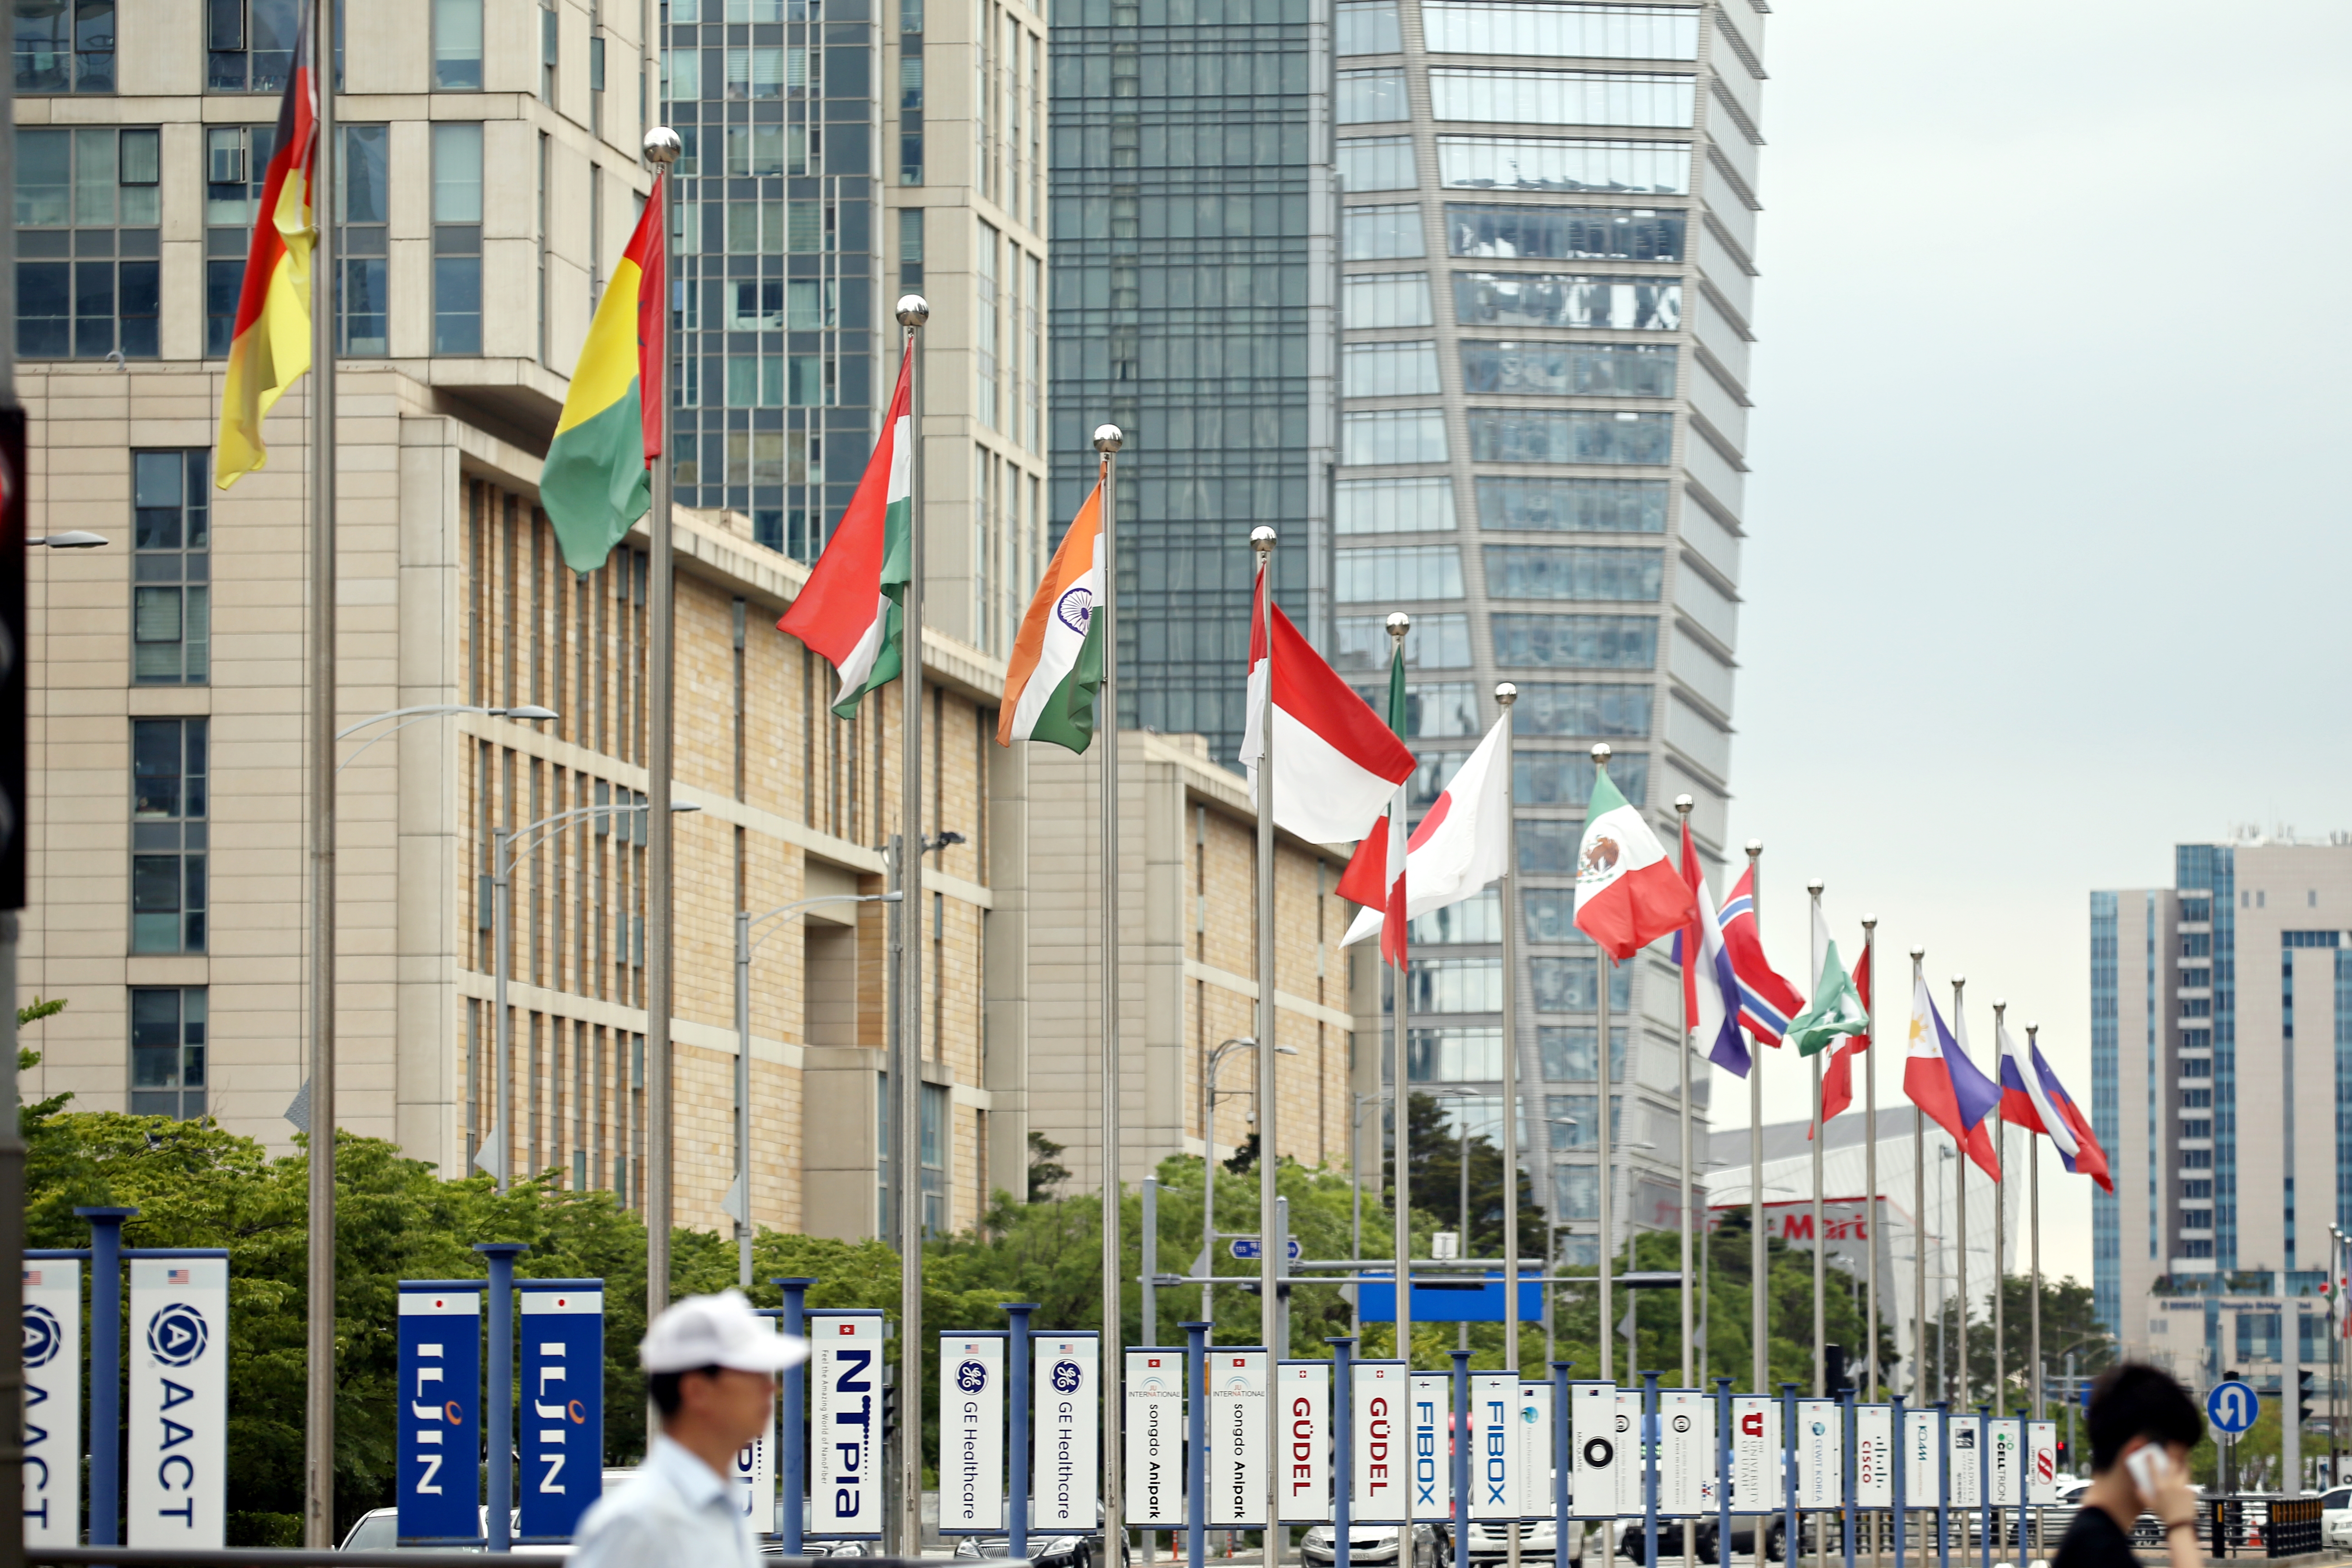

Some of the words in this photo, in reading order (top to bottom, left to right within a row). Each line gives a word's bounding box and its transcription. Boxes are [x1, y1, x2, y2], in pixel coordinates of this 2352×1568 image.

[820, 1381, 829, 1411] Amazing
[963, 1402, 978, 1423] GE
[1058, 1402, 1073, 1423] GE
[158, 1377, 194, 1529] AACT
[1147, 1404, 1160, 1456] songdo
[1232, 1404, 1245, 1455] songdo
[1293, 1397, 1313, 1497] GÜDEL
[1369, 1397, 1391, 1497] GÜDEL
[1416, 1401, 1435, 1506] FIBOX
[1487, 1401, 1505, 1505] FIBOX
[1741, 1441, 1749, 1453] OF
[1814, 1439, 1823, 1467] CEWIT
[963, 1429, 979, 1519] Healthcare
[1058, 1429, 1073, 1519] Healthcare
[1147, 1461, 1161, 1519] Anipark
[1232, 1461, 1245, 1519] Anipark
[1741, 1458, 1749, 1487] UTAH
[1749, 1441, 1759, 1504] UNIVERSITY
[1815, 1470, 1823, 1502] KOREA
[1862, 1441, 1872, 1483] CISCO
[1997, 1442, 2006, 1501] CELLTRION
